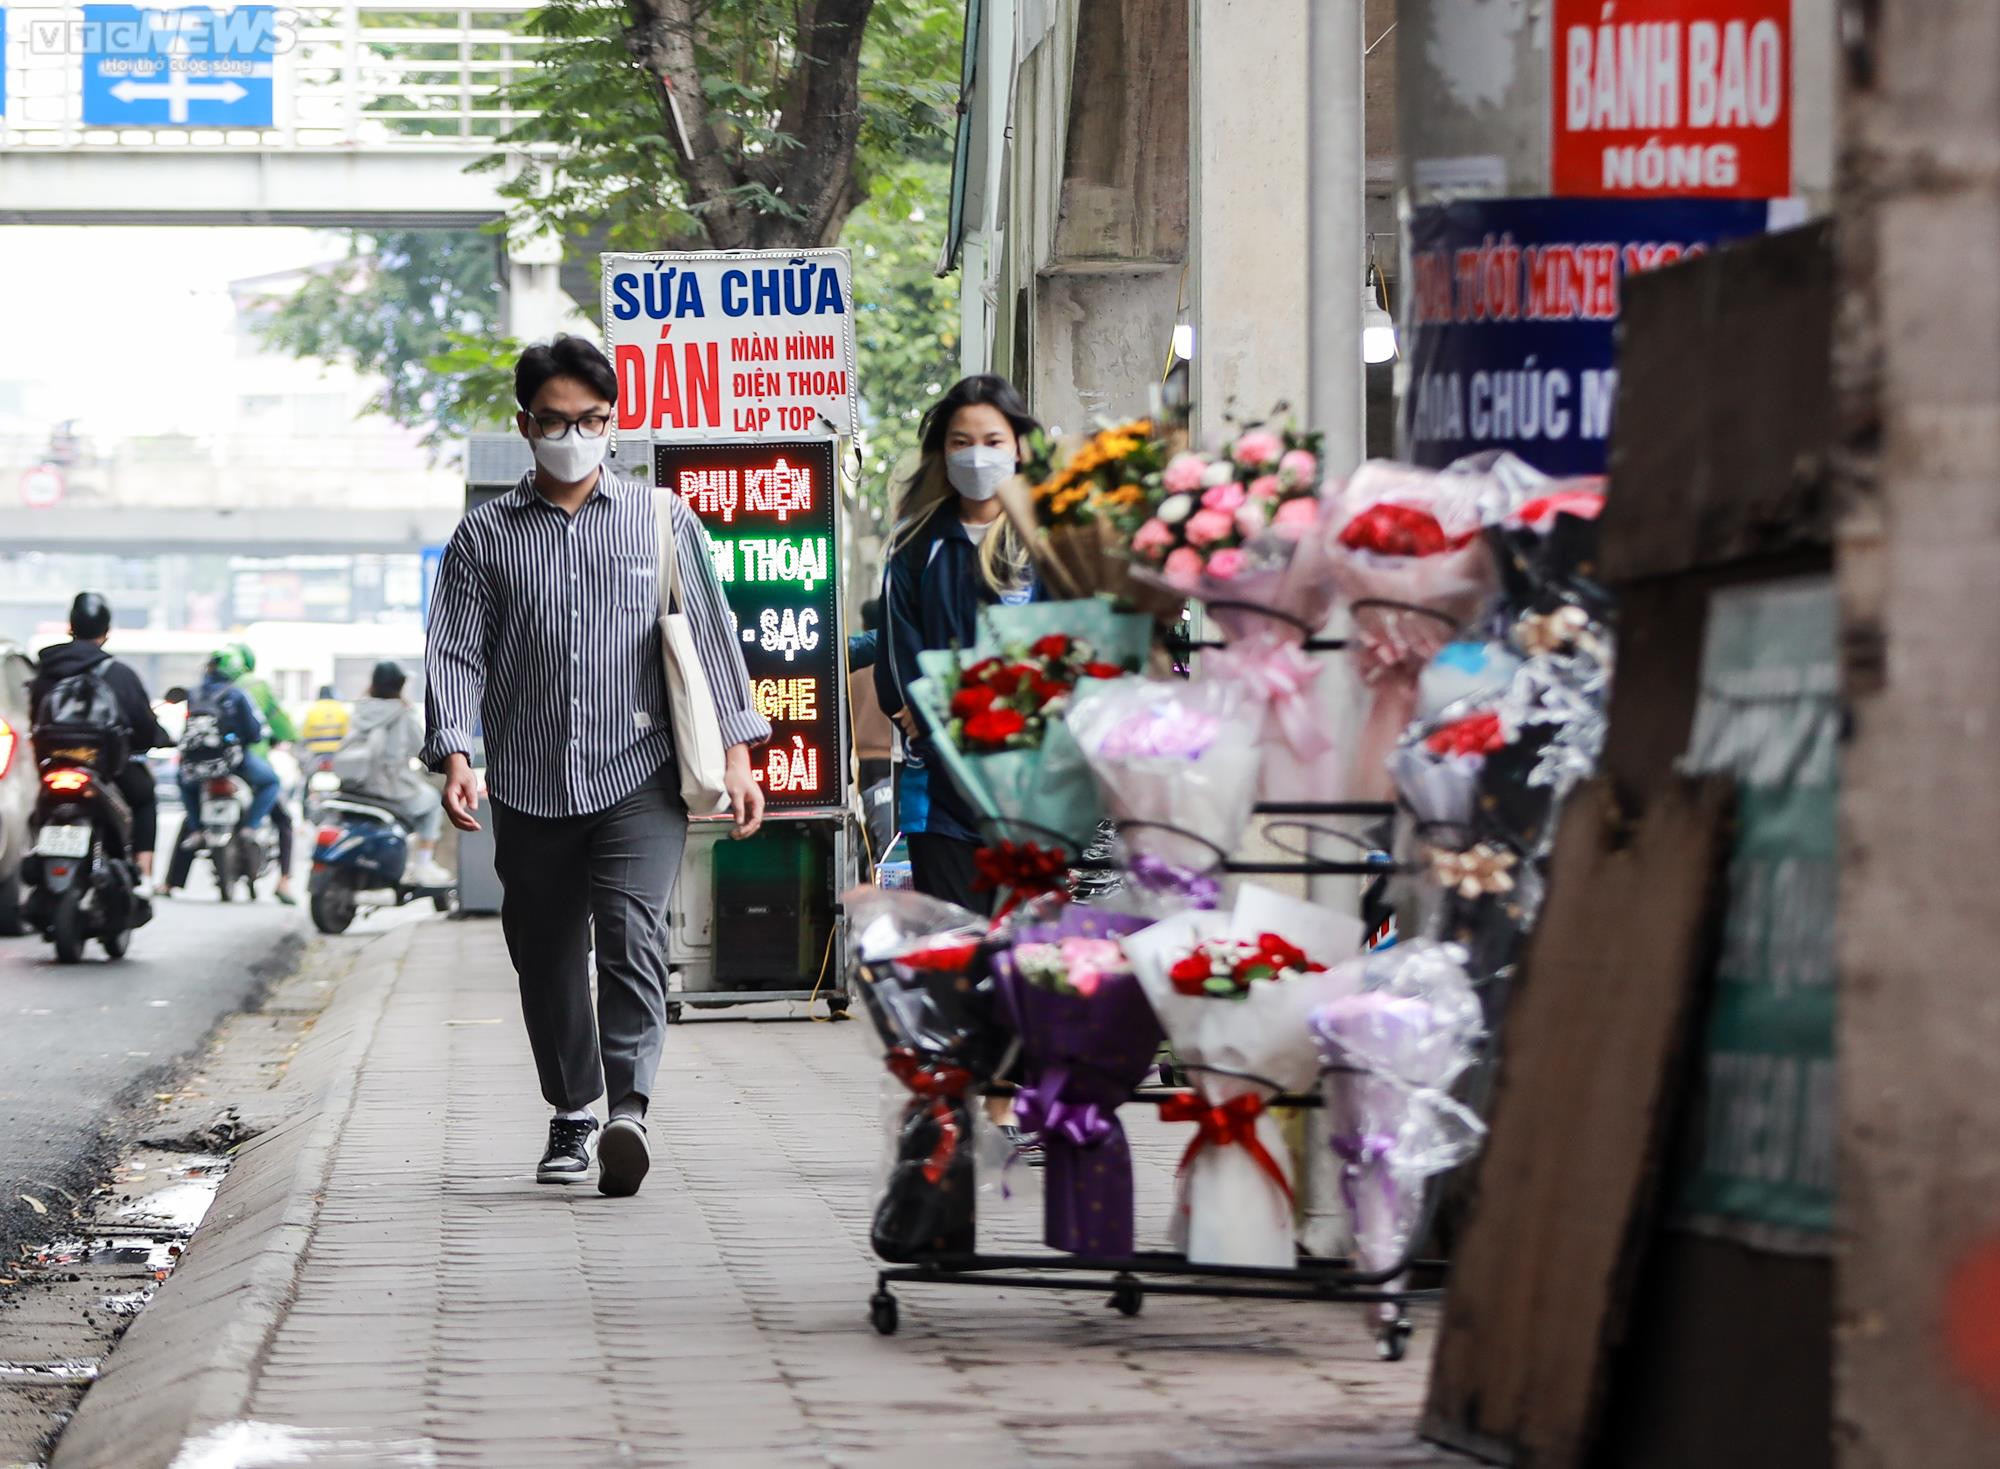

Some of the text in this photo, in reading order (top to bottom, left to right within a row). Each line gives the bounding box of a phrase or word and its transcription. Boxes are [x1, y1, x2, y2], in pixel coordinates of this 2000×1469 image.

[1566, 3, 1782, 131] BÁNH BAO
[1603, 136, 1739, 190] NÓNG
[721, 258, 845, 317] CHỮA
[1523, 243, 1621, 323] MINH
[731, 331, 834, 361] MÀN HÌNH
[615, 324, 721, 430] DÁN
[733, 367, 847, 402] ĐIỆN THOẠI
[1469, 355, 1571, 440] CHÚC
[733, 406, 815, 432] LAP TOP
[680, 458, 811, 522] PHỤ KIỆN
[738, 537, 827, 591] THOẠI
